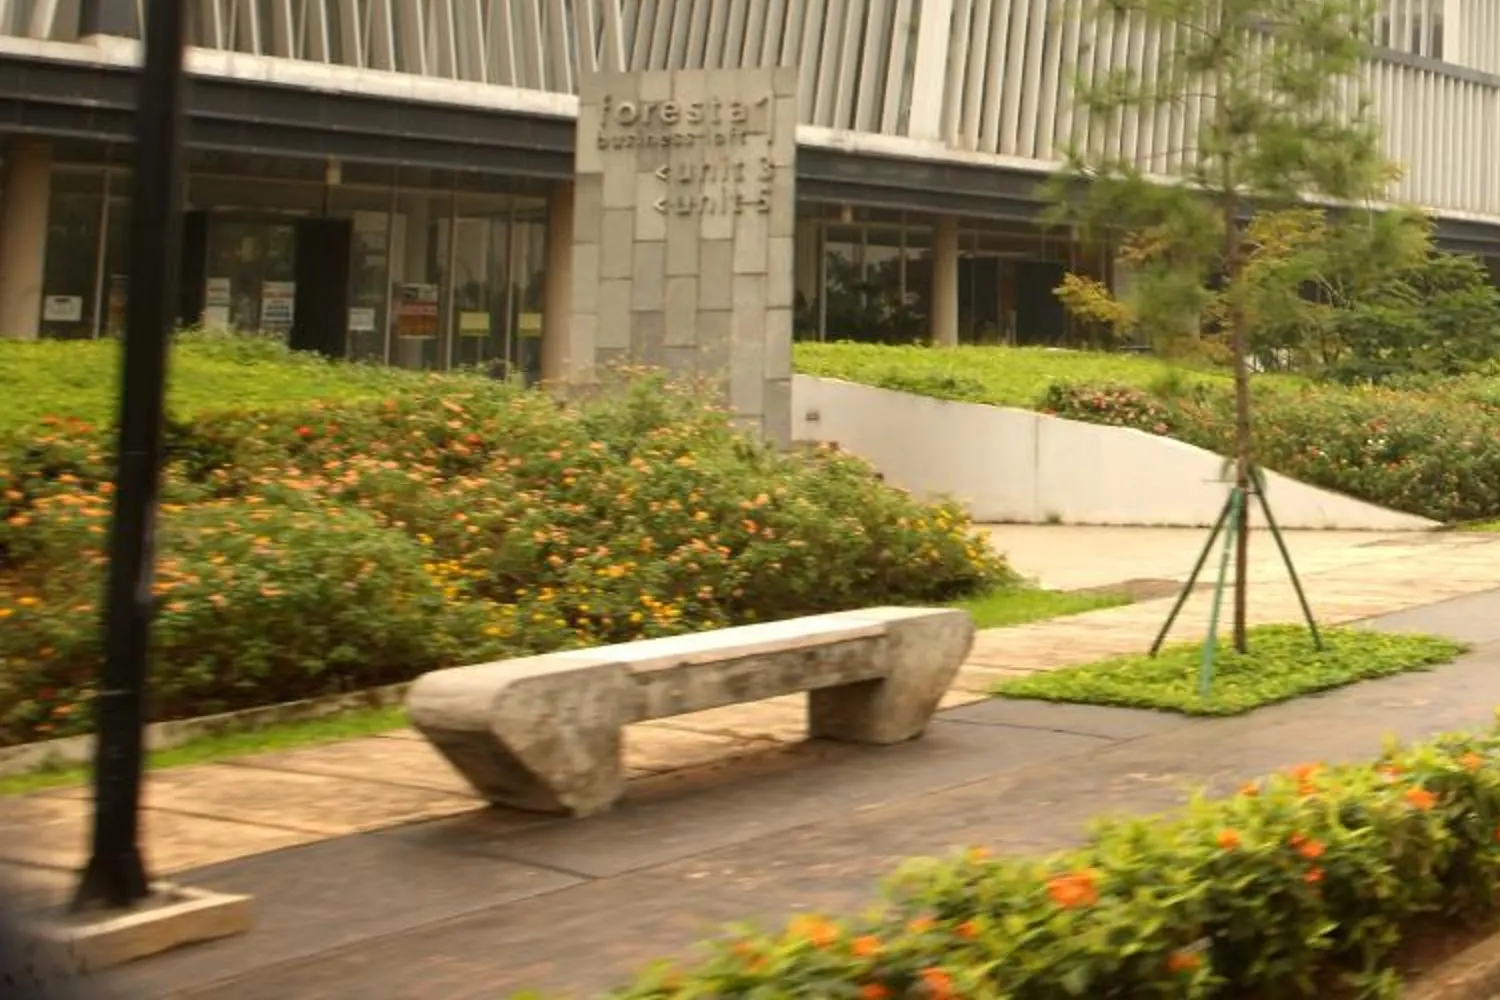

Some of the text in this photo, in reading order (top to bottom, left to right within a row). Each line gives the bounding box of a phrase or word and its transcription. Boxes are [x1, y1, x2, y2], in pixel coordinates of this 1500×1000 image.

[601, 96, 746, 128] foresta
[597, 130, 697, 149] business
[677, 158, 746, 183] unit
[675, 190, 743, 217] unit
